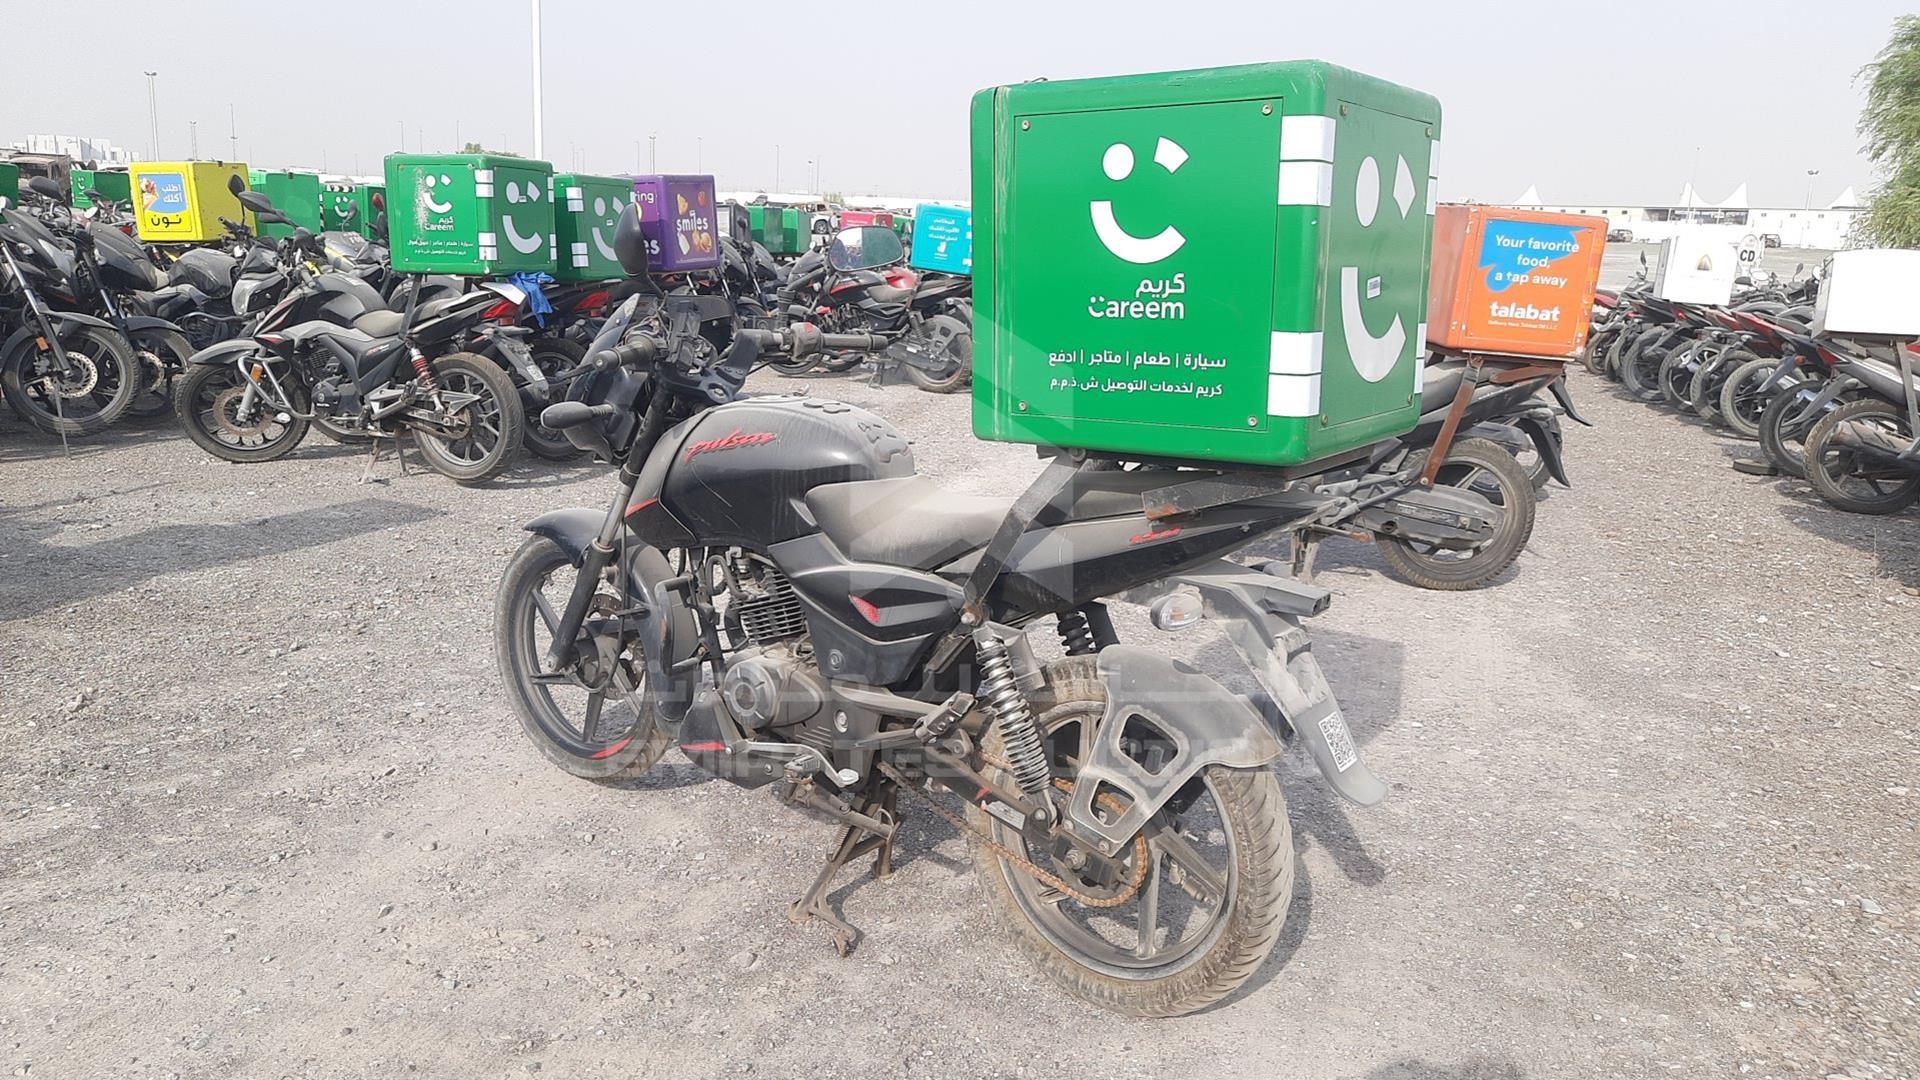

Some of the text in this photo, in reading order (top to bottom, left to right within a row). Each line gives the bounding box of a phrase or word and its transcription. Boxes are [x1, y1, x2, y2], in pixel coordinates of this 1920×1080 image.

[151, 214, 182, 228] نون
[676, 211, 709, 232] smiles
[1495, 234, 1580, 252] Your favorite
[1516, 254, 1551, 269] food,
[1740, 249, 1756, 262] CD
[1135, 272, 1186, 298] كريم
[1494, 271, 1568, 288] a tap away
[1087, 295, 1185, 319] Careem
[1489, 301, 1561, 321] talabat
[1048, 350, 1227, 370] سيارة طعام متاجر ادفع
[1101, 378, 1147, 391] التوصيل
[1150, 381, 1193, 394] لخدمات
[1195, 384, 1223, 398] كريم
